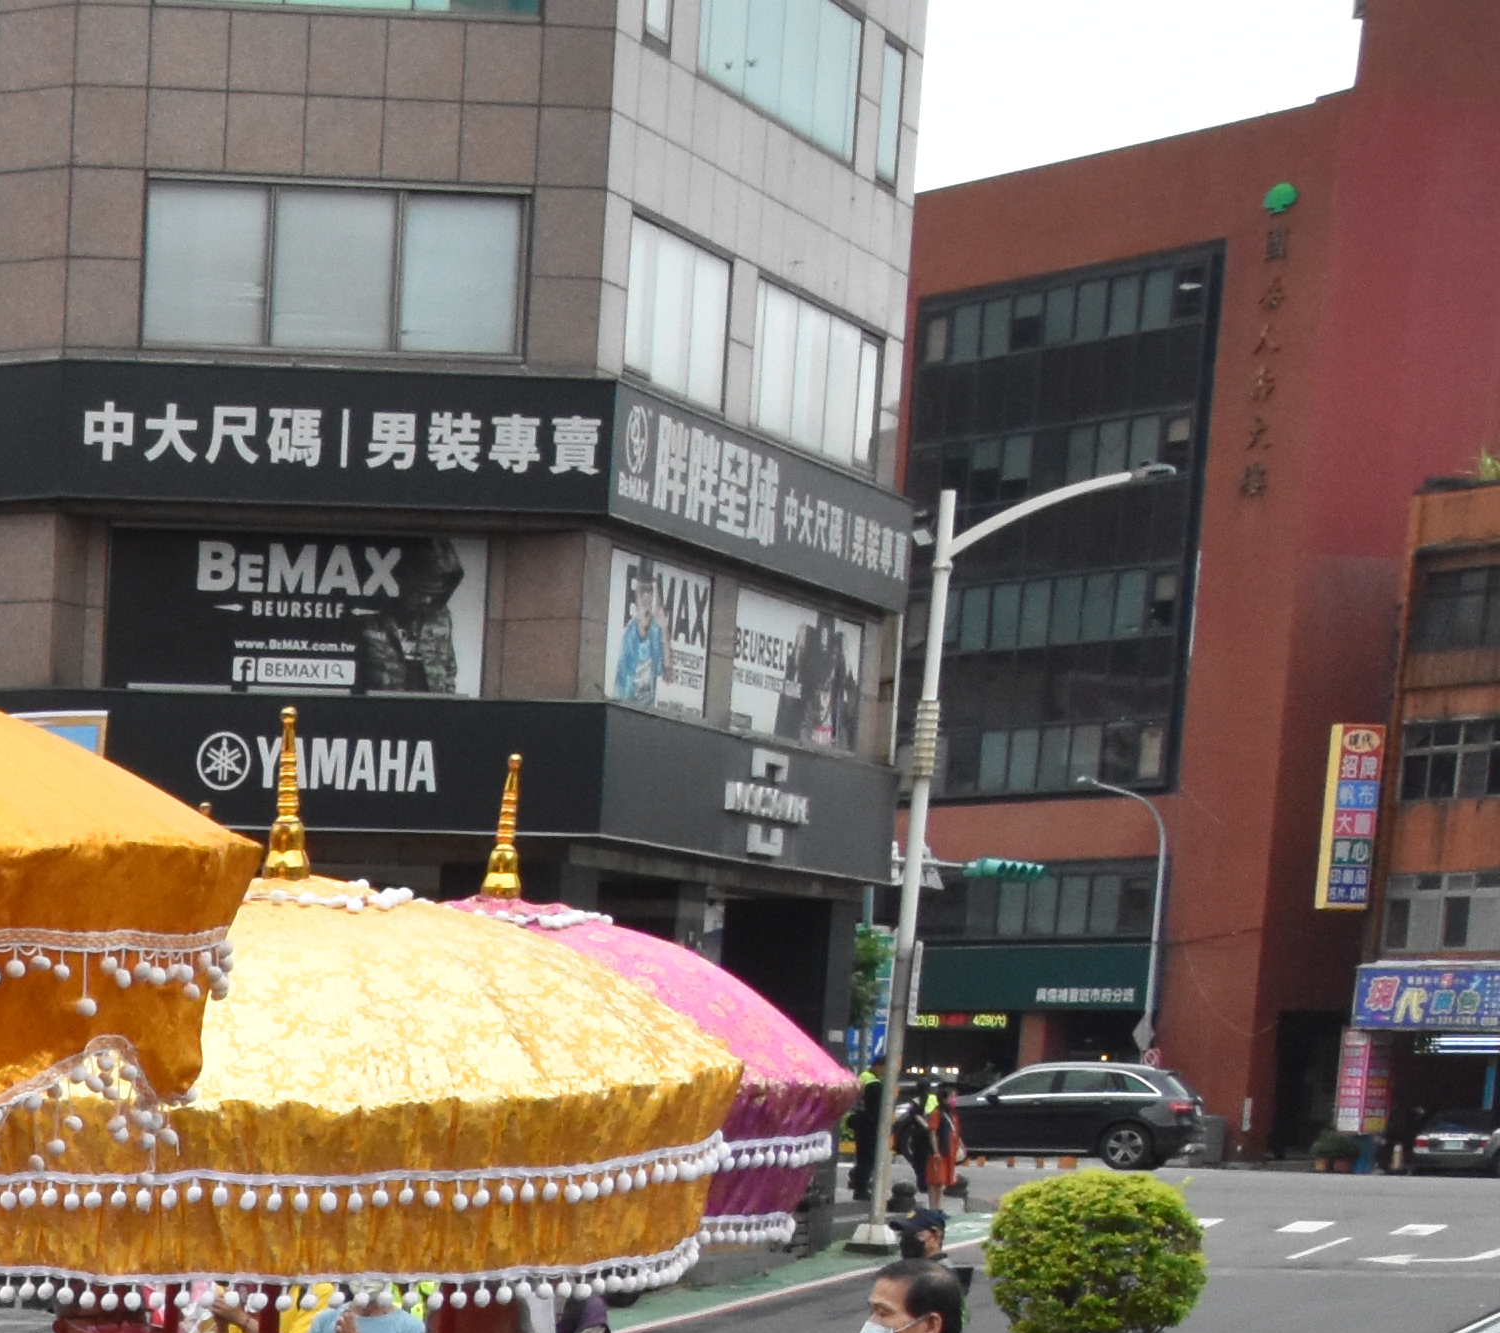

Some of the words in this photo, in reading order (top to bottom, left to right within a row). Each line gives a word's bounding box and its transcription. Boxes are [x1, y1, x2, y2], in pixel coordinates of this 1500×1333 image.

[652, 414, 780, 547] 胖胖星球
[251, 600, 345, 619] BEURSELF
[264, 662, 320, 679] BEMAX
[256, 735, 437, 793] YAMAHA
[1341, 754, 1379, 779] 招牌
